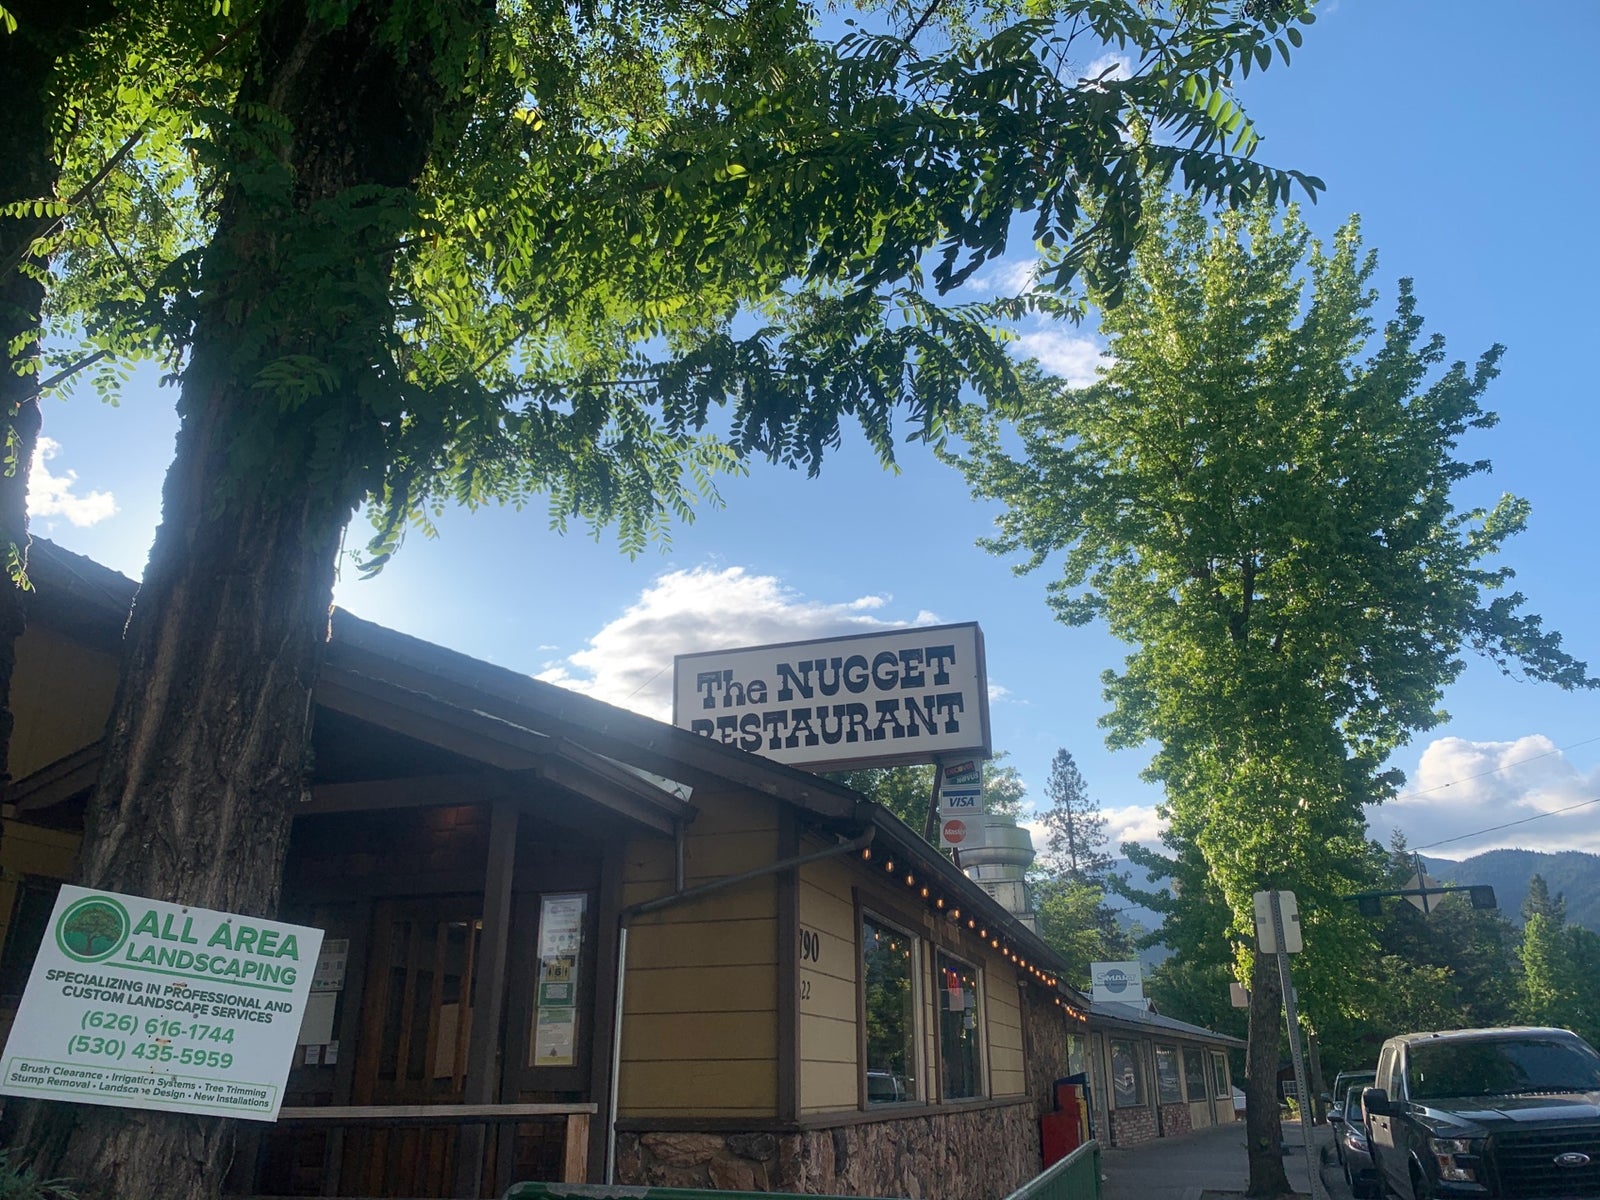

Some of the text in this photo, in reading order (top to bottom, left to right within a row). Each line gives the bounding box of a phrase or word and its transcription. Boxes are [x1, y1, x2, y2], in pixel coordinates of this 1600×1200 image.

[697, 644, 956, 709] The NUGGET
[949, 797, 974, 807] VISA
[133, 910, 299, 961] ALL AREA
[125, 942, 297, 985] LANDSCAPING
[45, 969, 293, 1014] SPECIALIZING IN PROFESSIONAL AND
[62, 985, 273, 1024] CUSTOM LANDSCAPE SERVICES
[81, 1010, 234, 1044] (626) 616-1744
[67, 1035, 233, 1069] (530) 435-5959
[11, 1072, 44, 1086] Stump
[47, 1076, 90, 1089] Removal
[152, 1087, 186, 1099] Design
[193, 1092, 215, 1102] New
[216, 1096, 270, 1108] Installations
[20, 1063, 50, 1075] Brush
[53, 1066, 103, 1080] Clearance
[157, 1078, 196, 1090] Systems
[204, 1083, 224, 1093] Tree
[226, 1085, 267, 1099] Trimming
